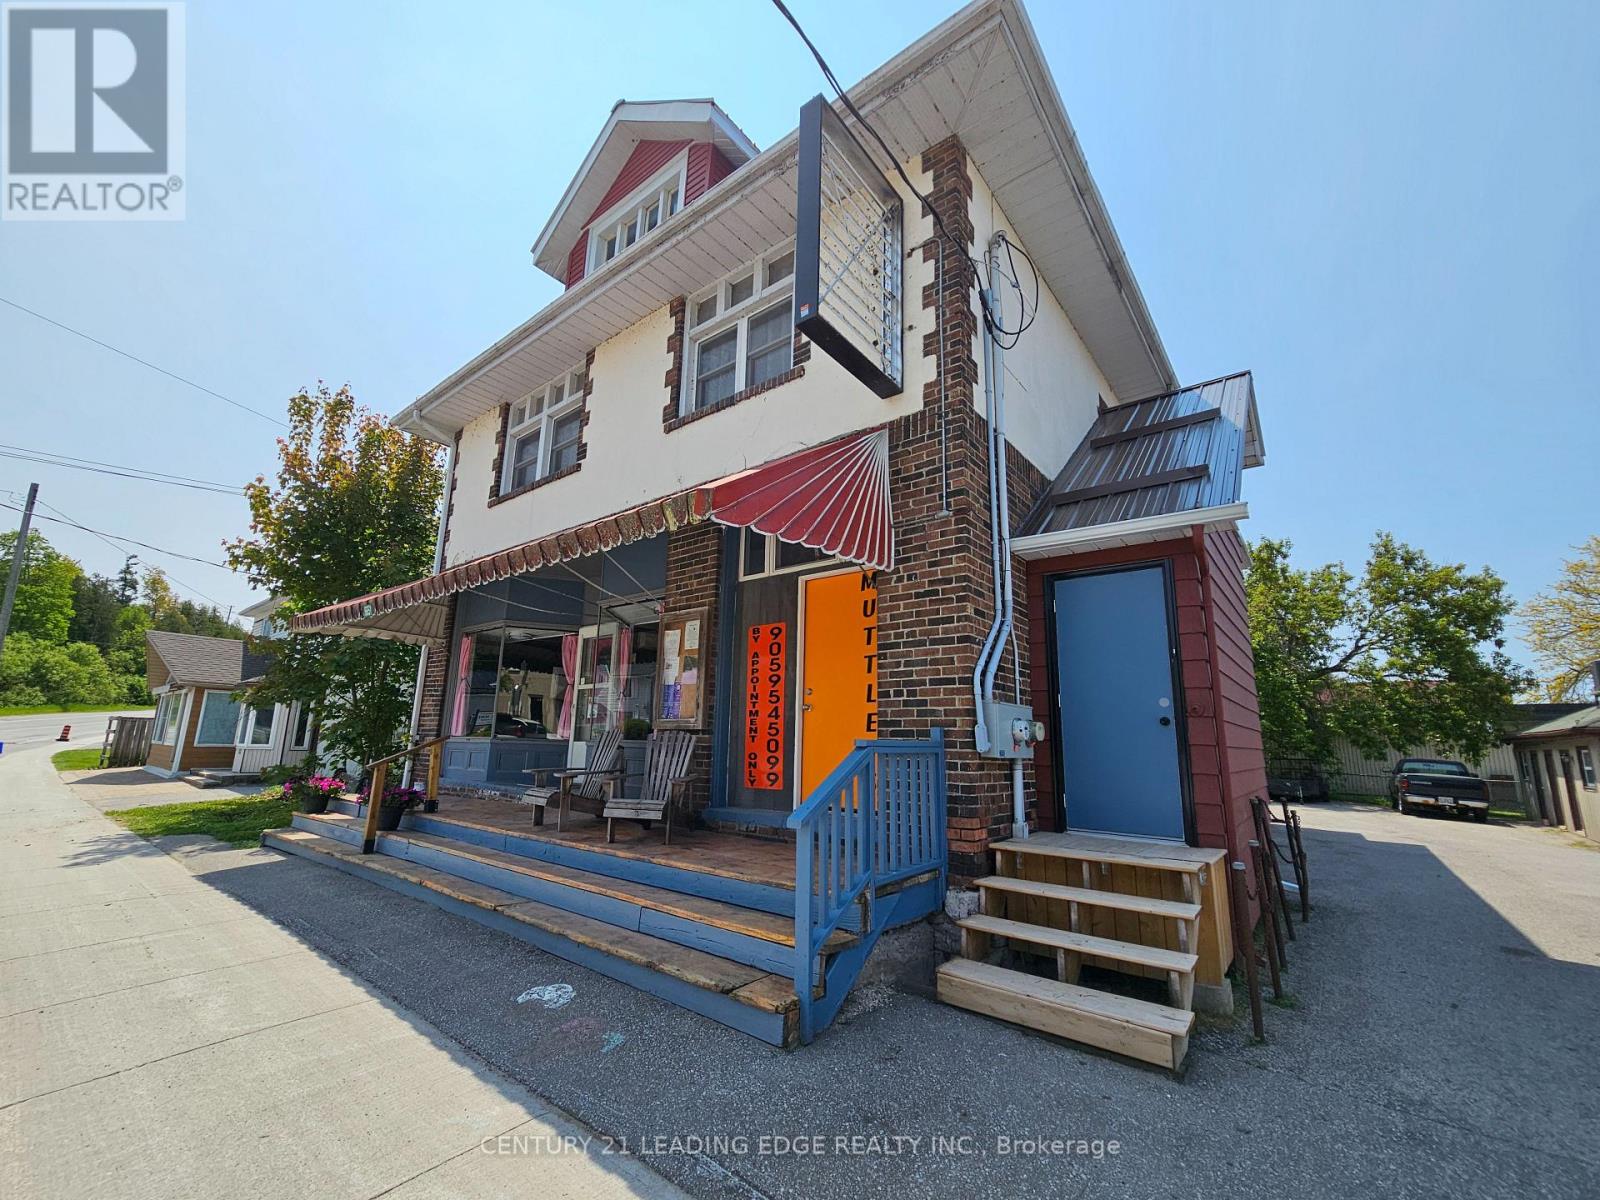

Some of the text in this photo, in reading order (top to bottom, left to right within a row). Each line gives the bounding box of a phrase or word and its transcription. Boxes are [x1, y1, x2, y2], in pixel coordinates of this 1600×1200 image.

[747, 627, 761, 787] BY APPOINTMENT ONLY
[766, 626, 783, 787] 9059545099
